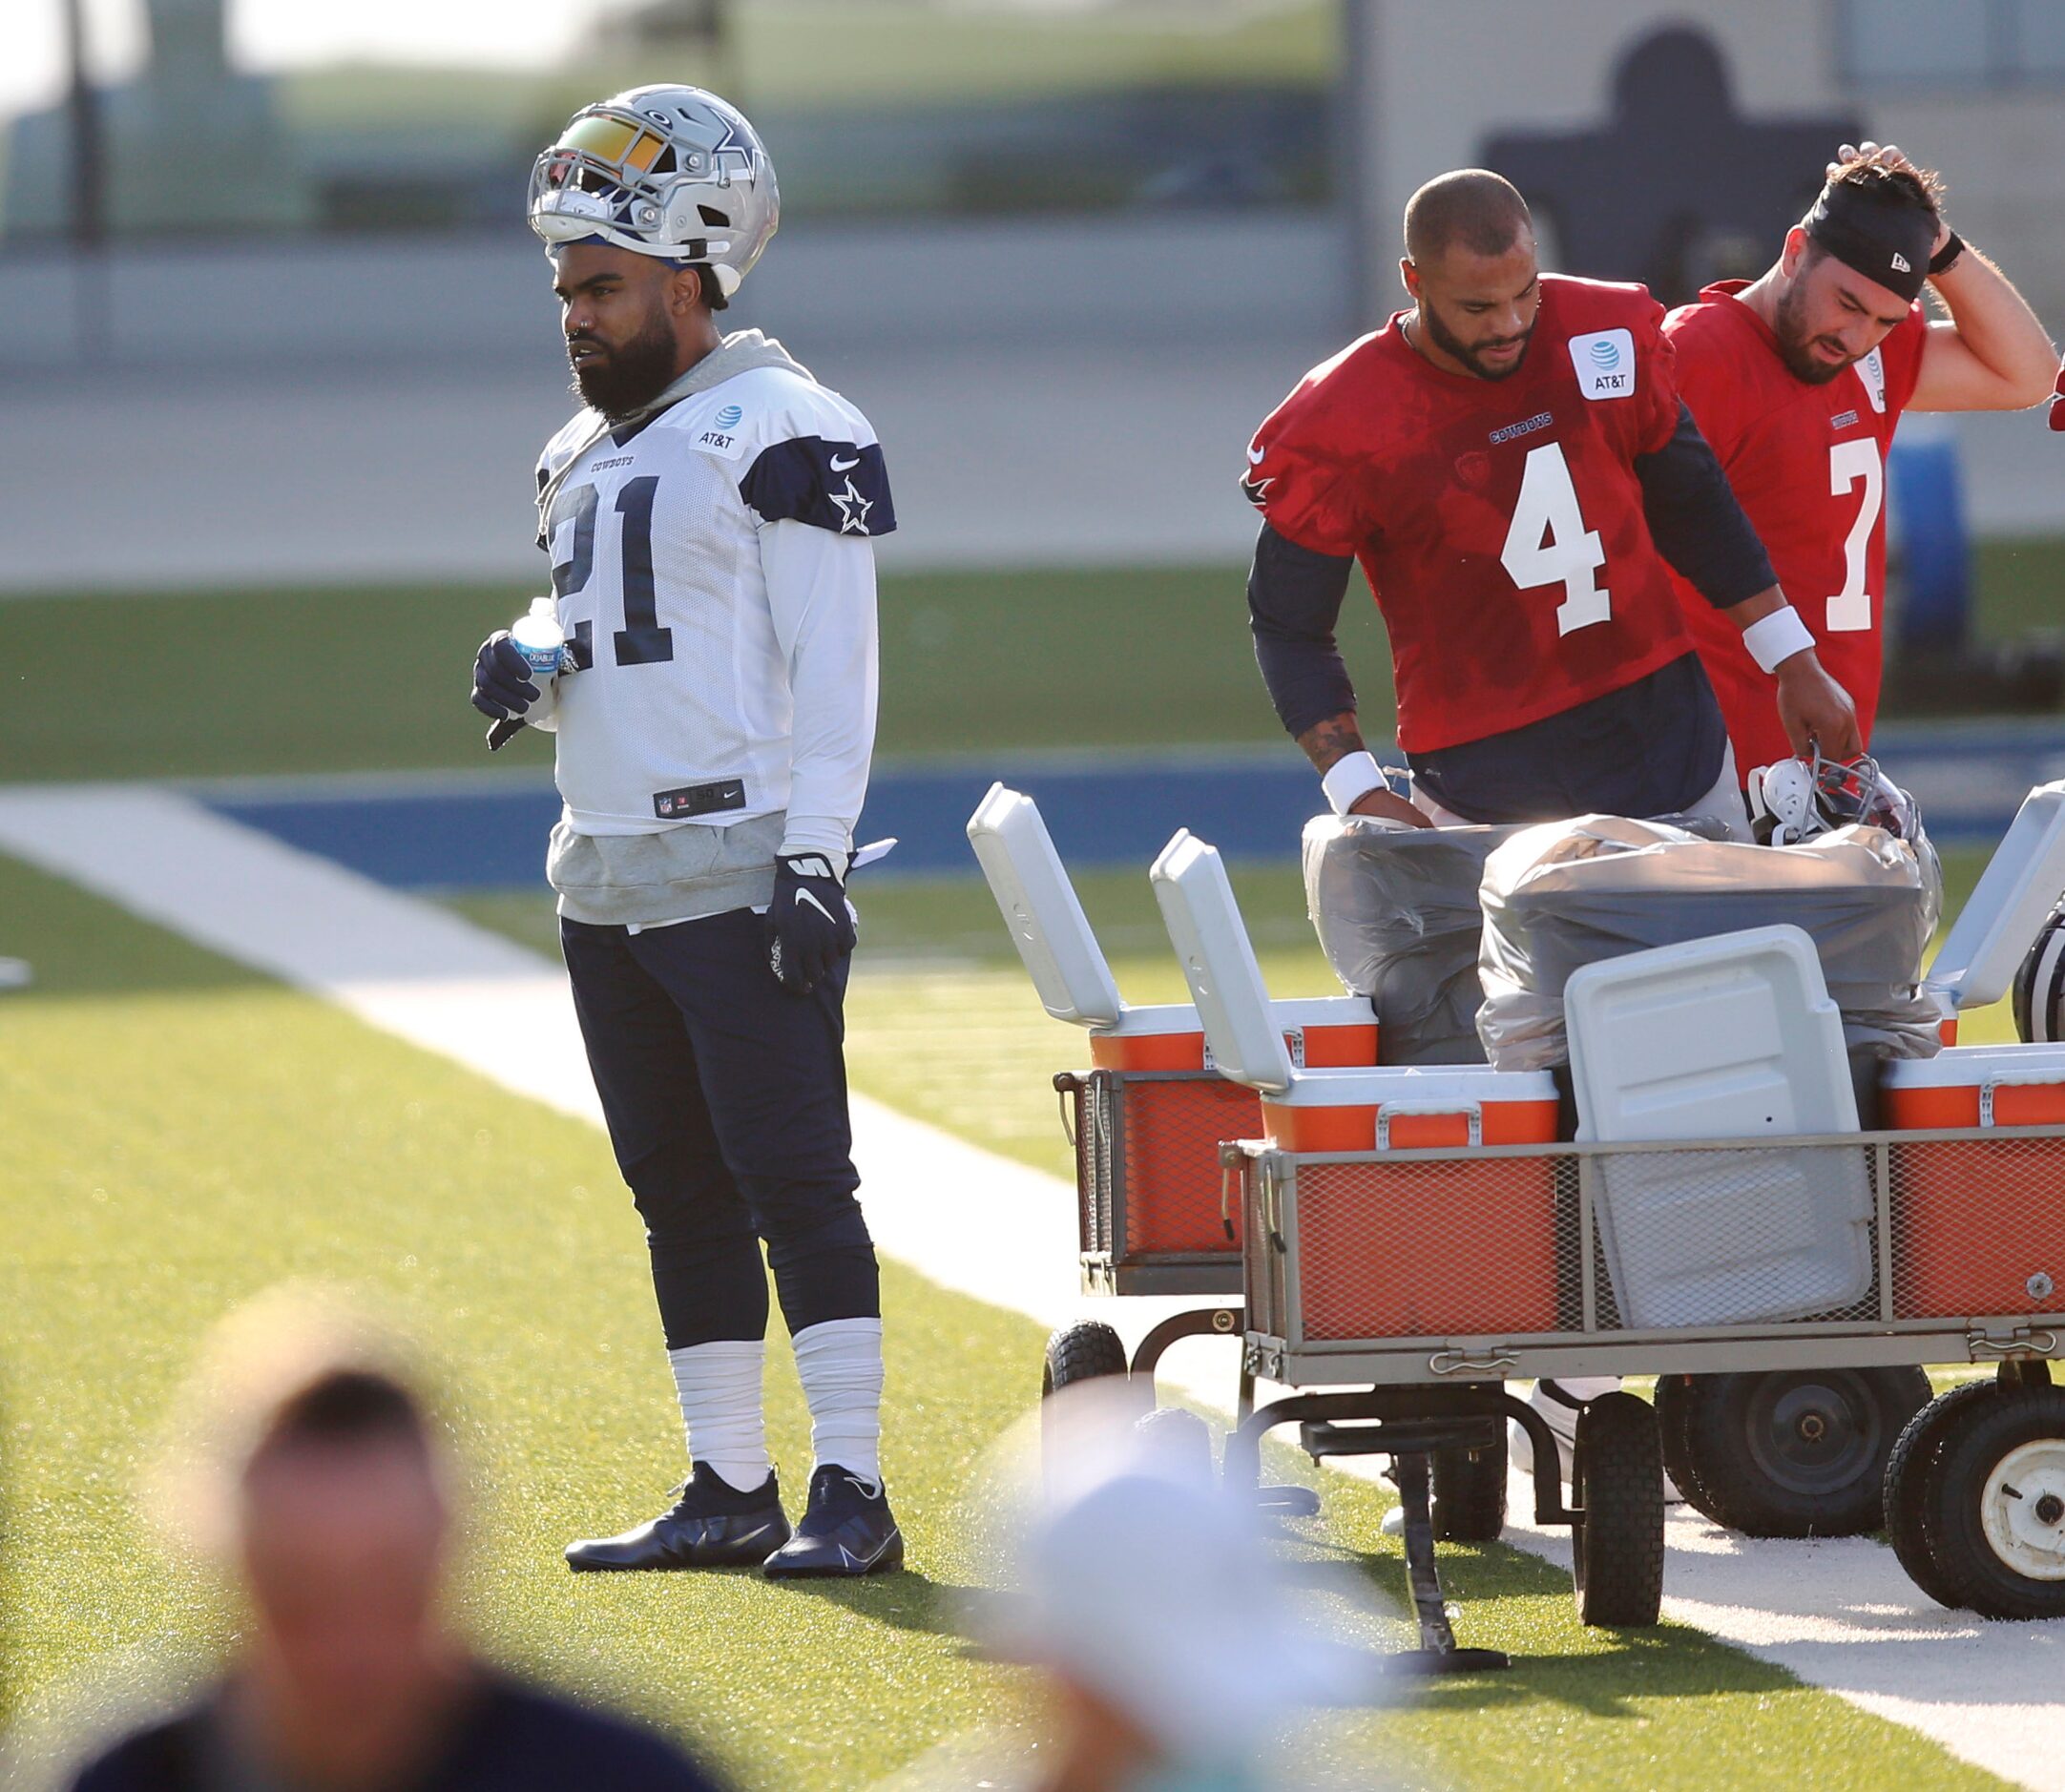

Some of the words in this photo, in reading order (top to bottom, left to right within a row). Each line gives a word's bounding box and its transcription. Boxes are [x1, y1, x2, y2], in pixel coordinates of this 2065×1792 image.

[1596, 374, 1626, 390] AT&T
[698, 431, 736, 449] AT&T
[1489, 411, 1554, 445] COWBOYS
[591, 456, 635, 473] COWBOYS
[1500, 442, 1612, 638] 4
[1825, 436, 1884, 633] 7
[548, 475, 674, 677] 21
